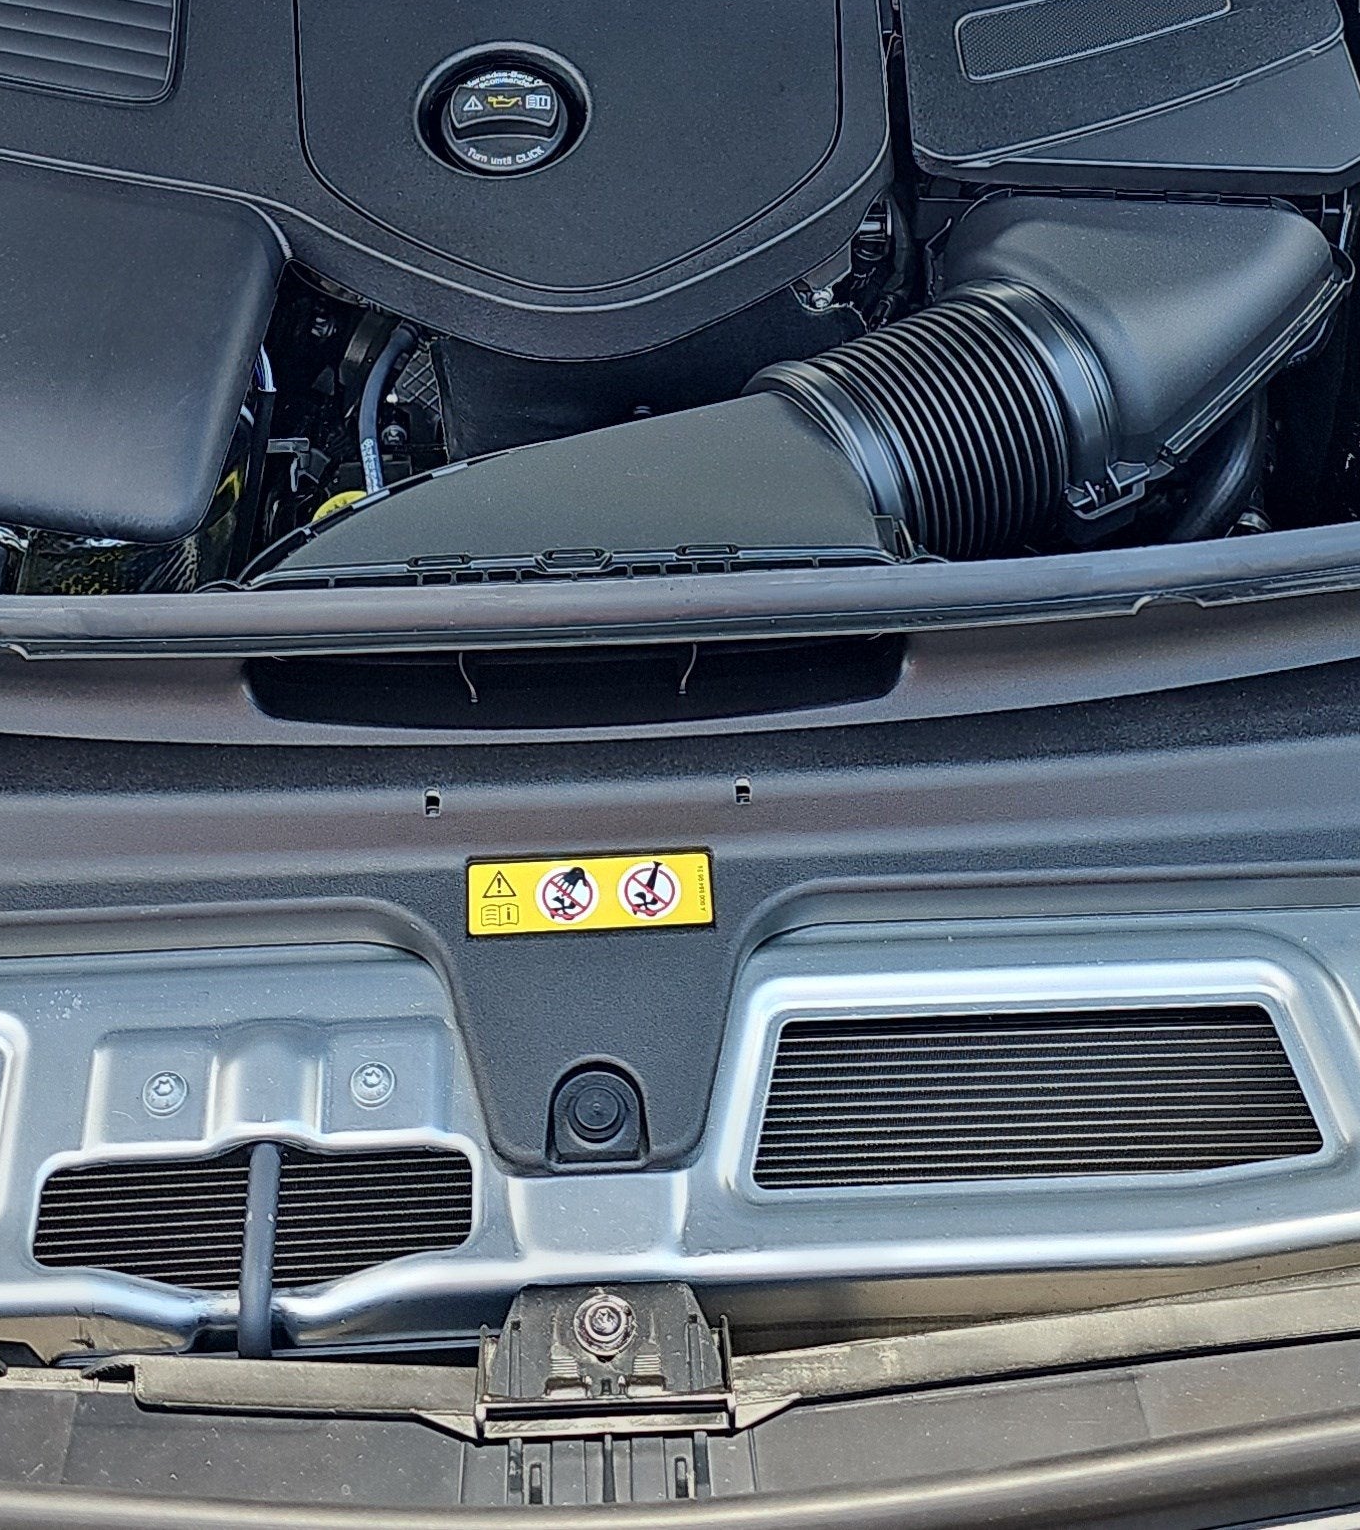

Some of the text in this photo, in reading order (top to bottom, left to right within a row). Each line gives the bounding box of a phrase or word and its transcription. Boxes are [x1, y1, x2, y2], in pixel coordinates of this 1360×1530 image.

[467, 145, 545, 165] Turn until CLICK
